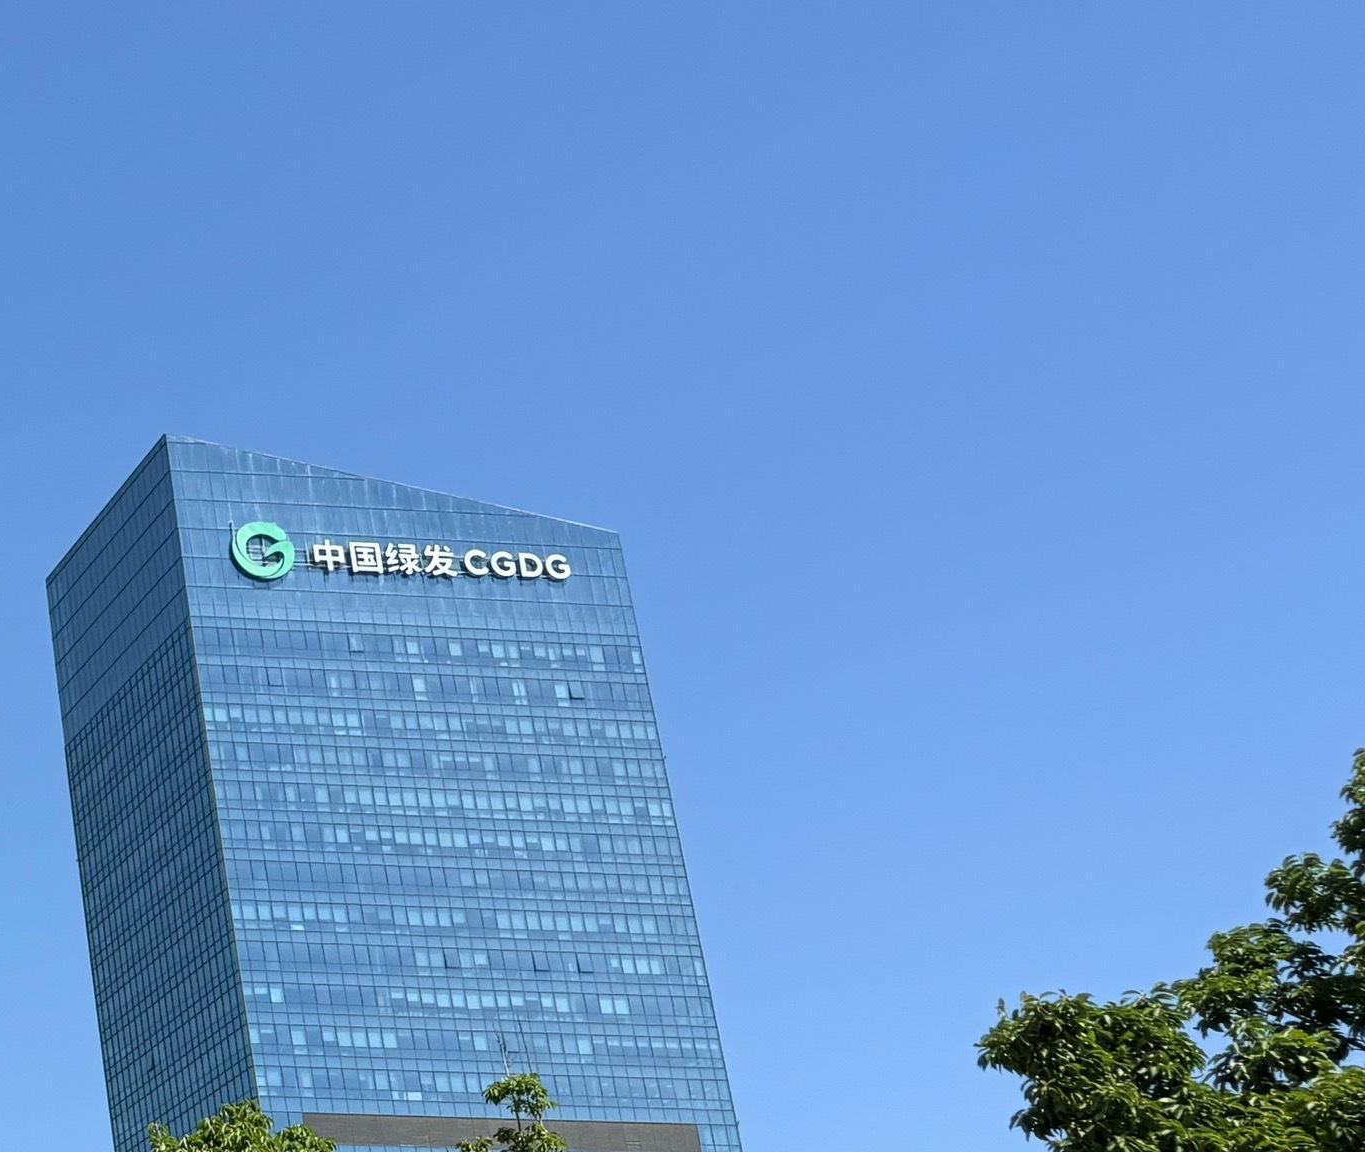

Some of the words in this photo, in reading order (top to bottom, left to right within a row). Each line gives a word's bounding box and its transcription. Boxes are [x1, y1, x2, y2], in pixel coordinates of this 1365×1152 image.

[313, 540, 458, 577] 中国绿发
[463, 549, 571, 580] CGDG
